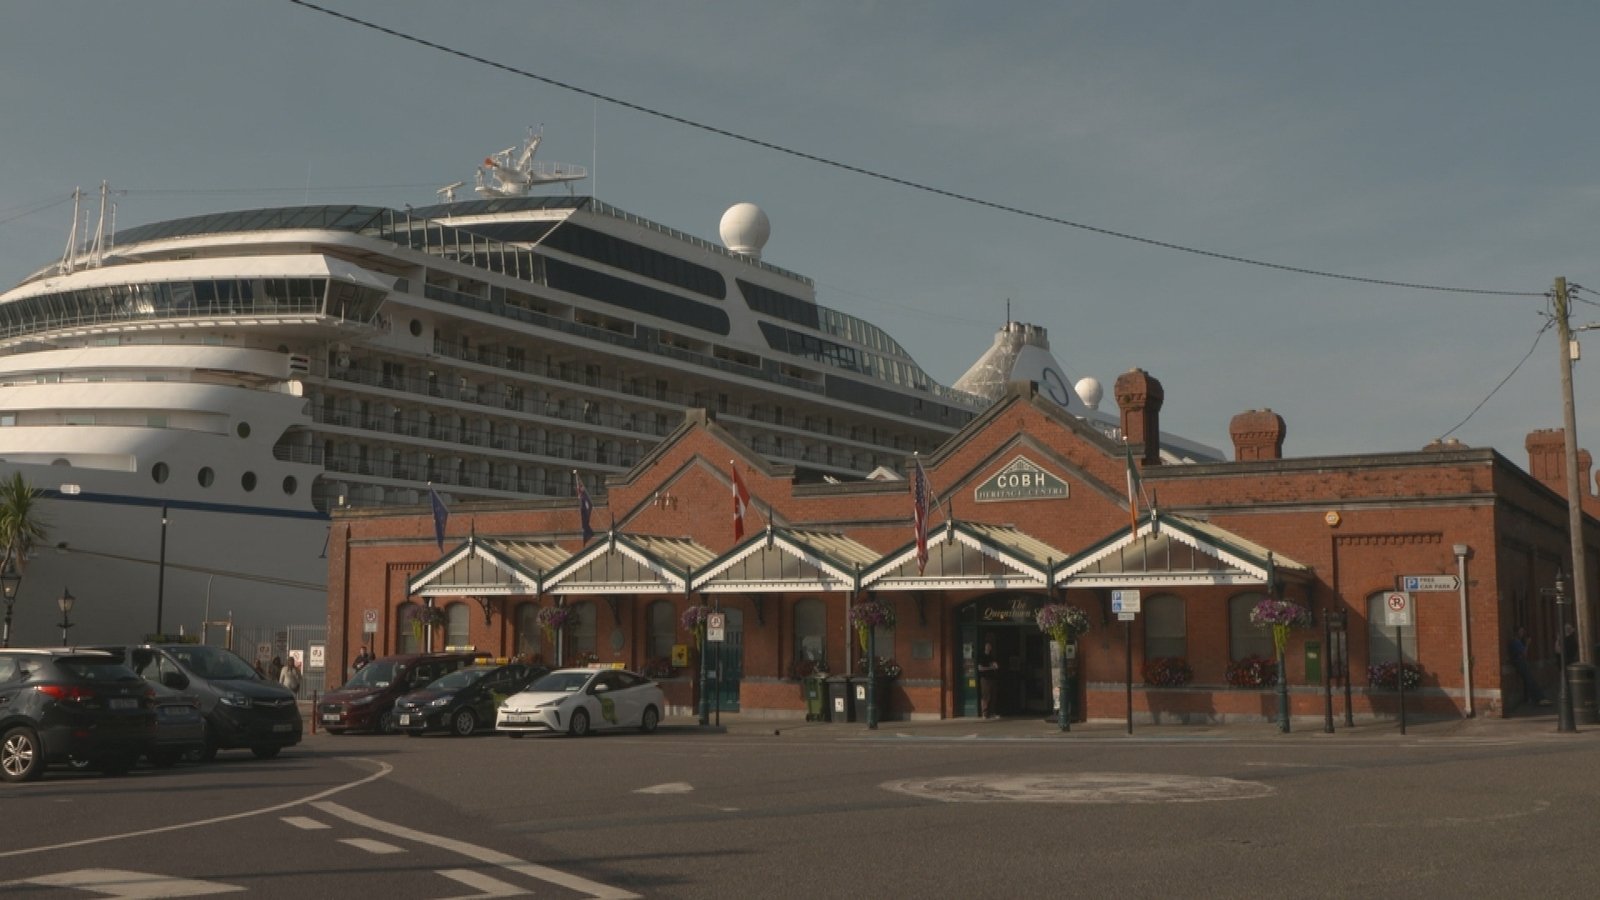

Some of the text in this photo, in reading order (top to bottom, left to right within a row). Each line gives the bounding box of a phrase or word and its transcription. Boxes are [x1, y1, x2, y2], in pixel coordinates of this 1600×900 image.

[997, 473, 1045, 488] COBH
[979, 487, 1063, 498] HERITAGE CENTRE
